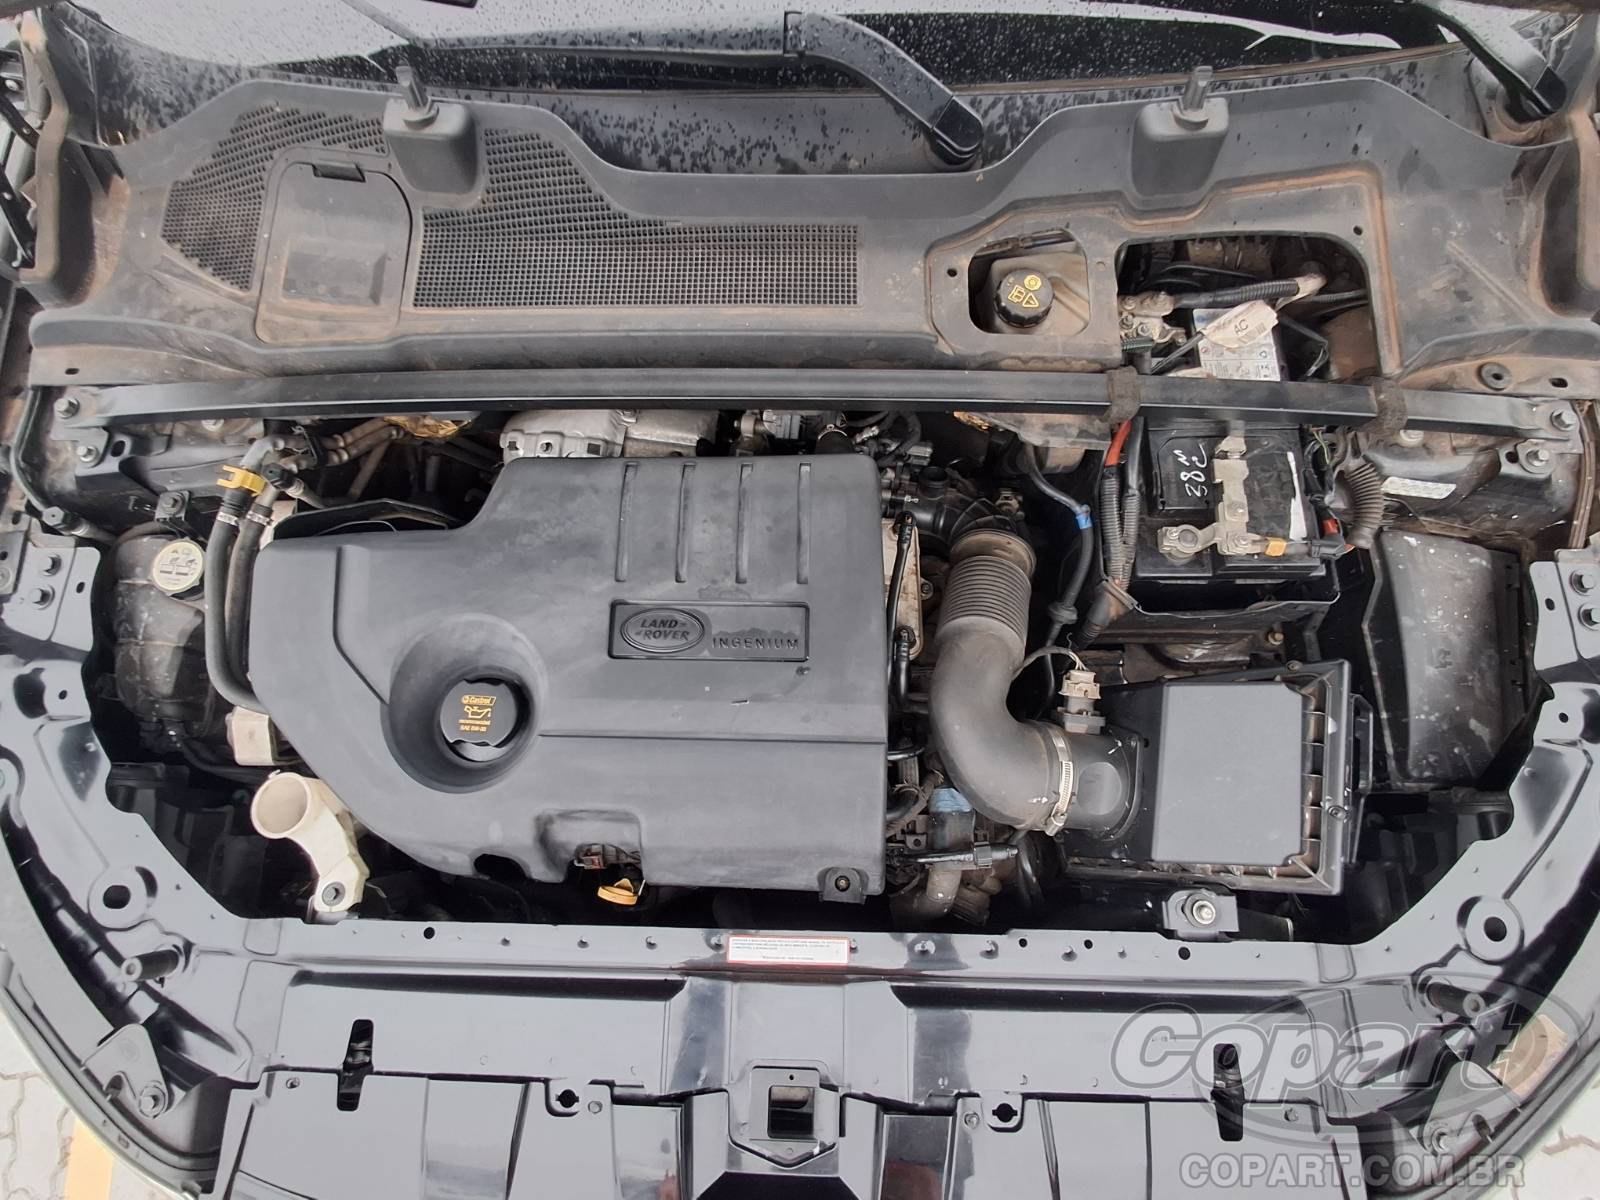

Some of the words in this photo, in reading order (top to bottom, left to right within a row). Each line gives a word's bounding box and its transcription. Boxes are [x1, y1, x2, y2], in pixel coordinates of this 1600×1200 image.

[1233, 318, 1249, 335] AC
[640, 618, 679, 629] LAND
[642, 629, 690, 641] ROVER
[712, 636, 800, 650] INGENIUM
